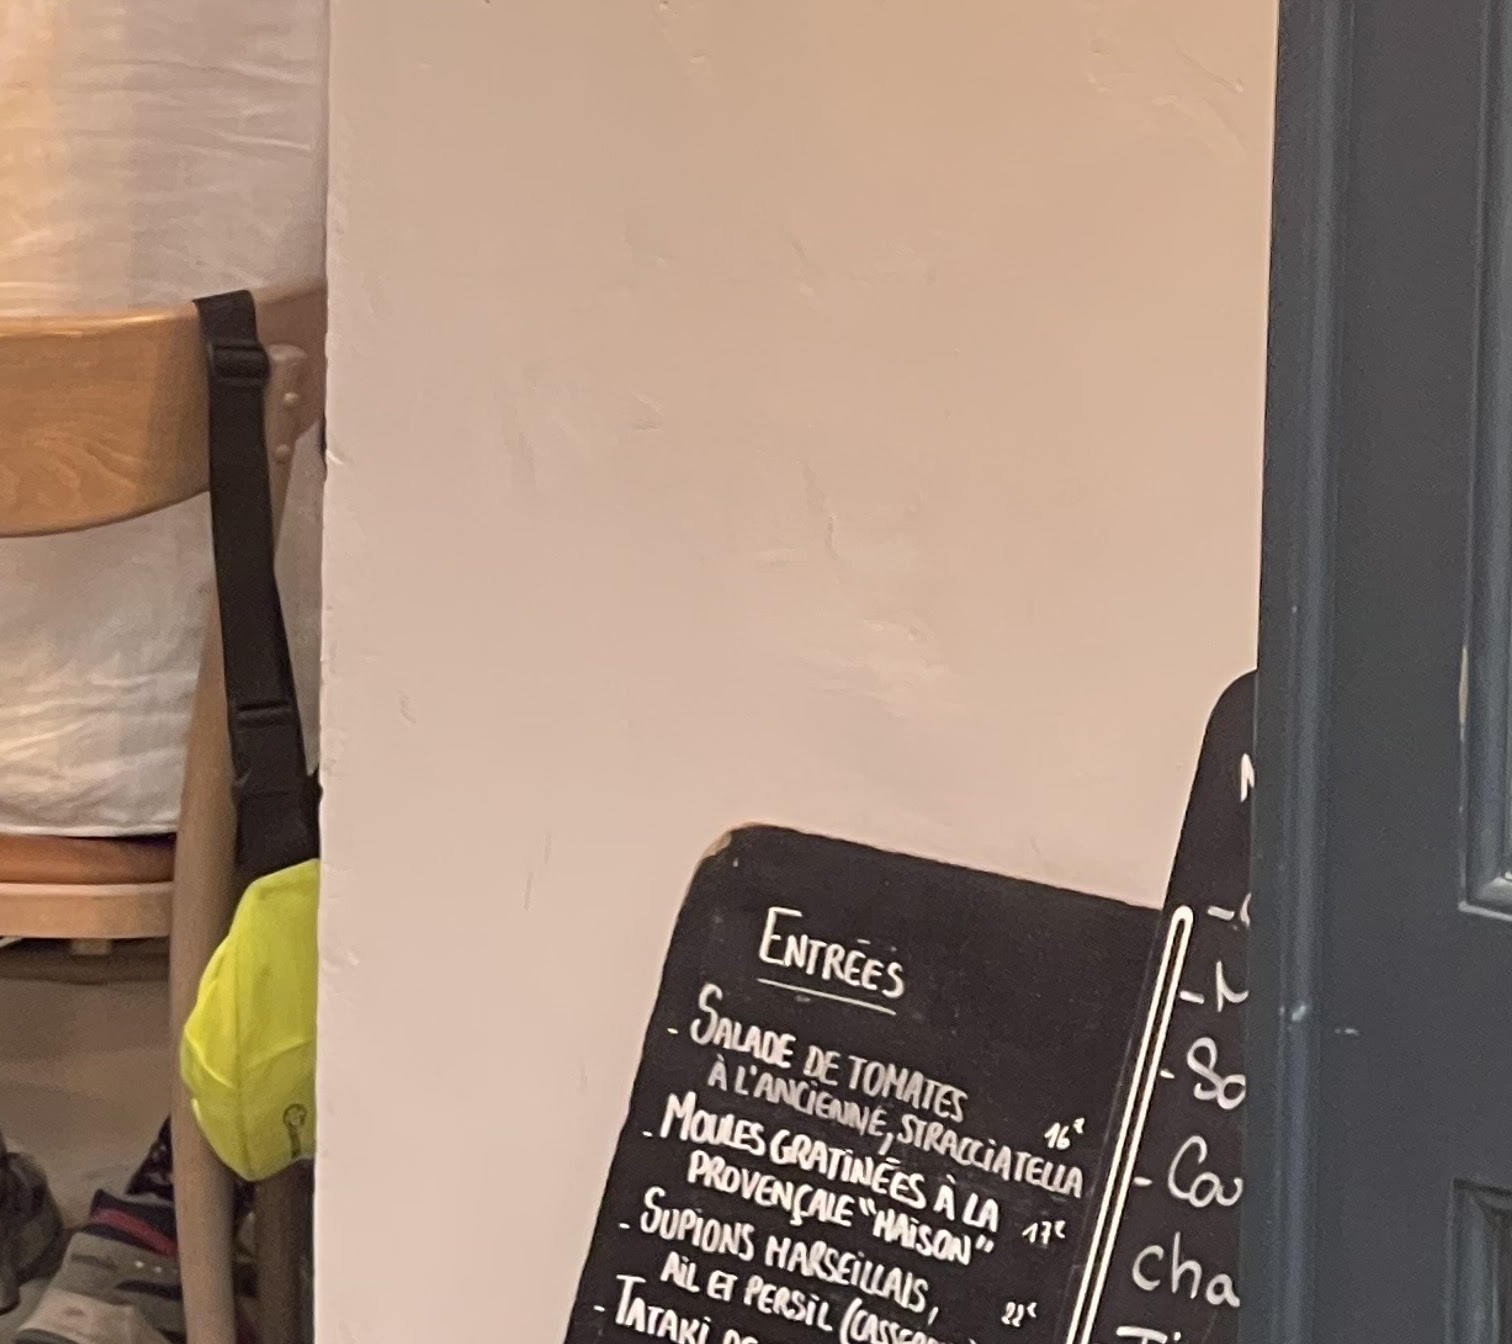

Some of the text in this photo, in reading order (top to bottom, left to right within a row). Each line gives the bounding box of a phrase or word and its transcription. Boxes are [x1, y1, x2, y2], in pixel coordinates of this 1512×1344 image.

[690, 983, 968, 1122] SALADE DE TOMATES
[707, 1053, 727, 1091] À
[660, 1091, 765, 1156] MOULES
[933, 1174, 955, 1221] À
[962, 1193, 999, 1232] LA
[688, 1150, 854, 1227] PROVENÇALE
[707, 1270, 738, 1301] ET
